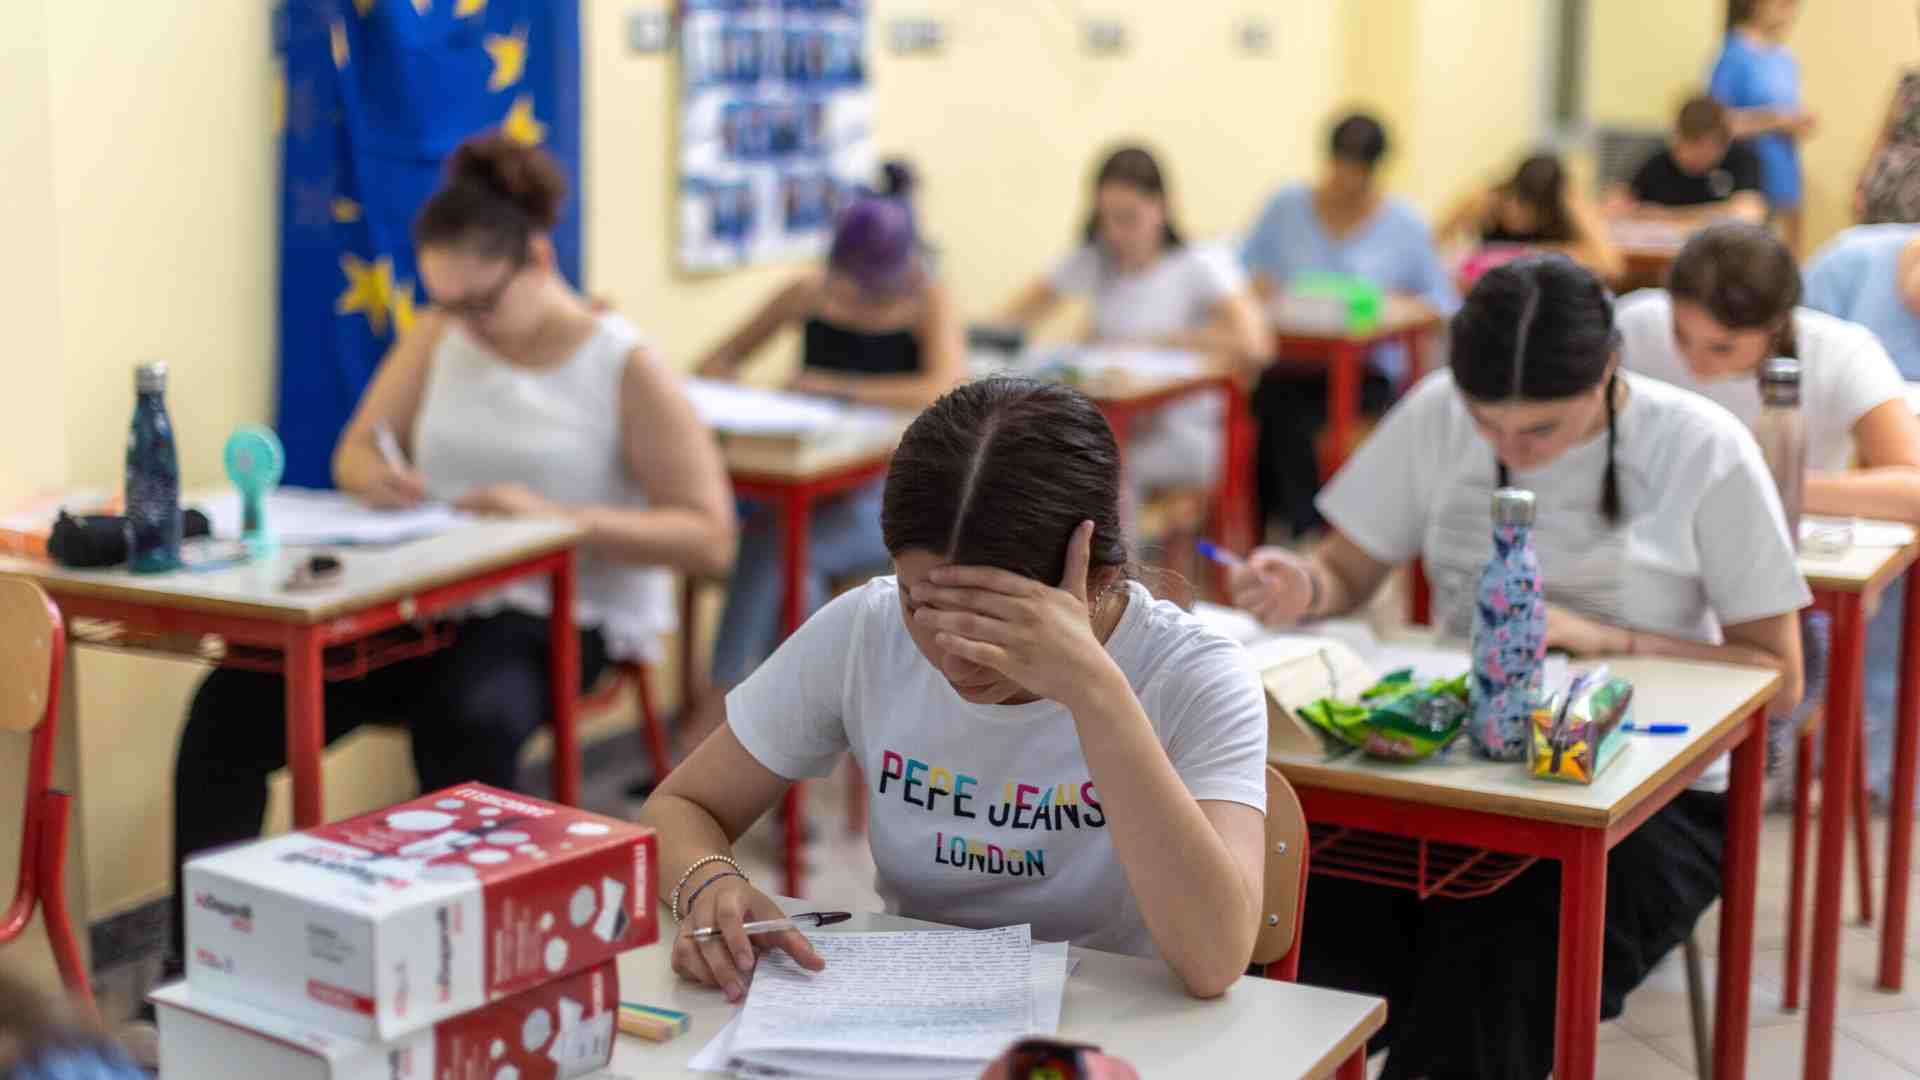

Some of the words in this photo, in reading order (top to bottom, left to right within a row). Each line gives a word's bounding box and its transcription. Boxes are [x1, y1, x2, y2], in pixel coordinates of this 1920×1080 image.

[878, 750, 978, 819] PEPE
[988, 781, 1107, 831] JEANS
[935, 832, 1047, 877] LONDON
